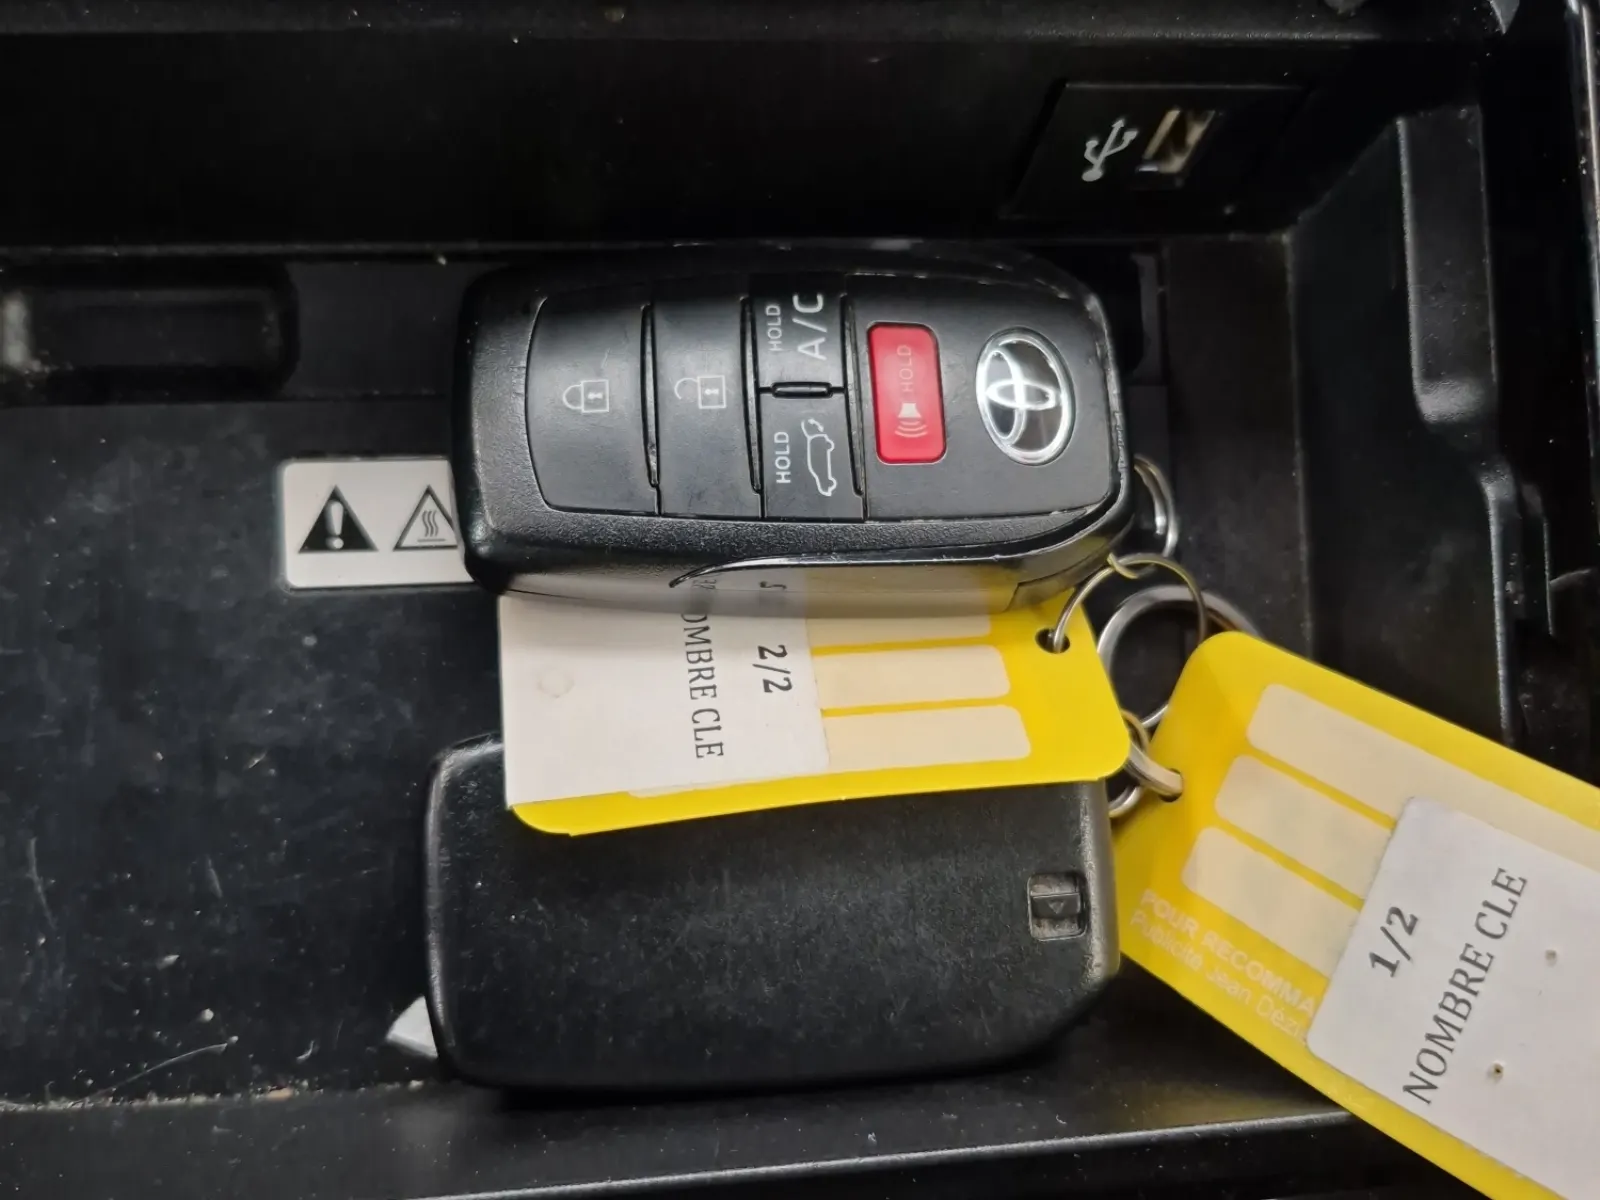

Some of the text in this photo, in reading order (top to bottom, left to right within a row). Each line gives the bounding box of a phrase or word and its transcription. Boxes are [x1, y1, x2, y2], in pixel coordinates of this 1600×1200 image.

[766, 305, 783, 351] HOLD
[792, 294, 827, 361] A/C
[897, 344, 914, 392] HOLD
[774, 431, 792, 484] HOLD
[681, 613, 718, 700] OMBRE
[752, 644, 793, 693] 2/2
[691, 708, 724, 759] CLE
[1140, 888, 1315, 1018] POUR RECOMMA
[1368, 906, 1419, 978] 1/2
[1205, 966, 1254, 1005] Jean
[1255, 994, 1306, 1042] Dézi
[1402, 867, 1528, 1105] NOMBRE CLE
